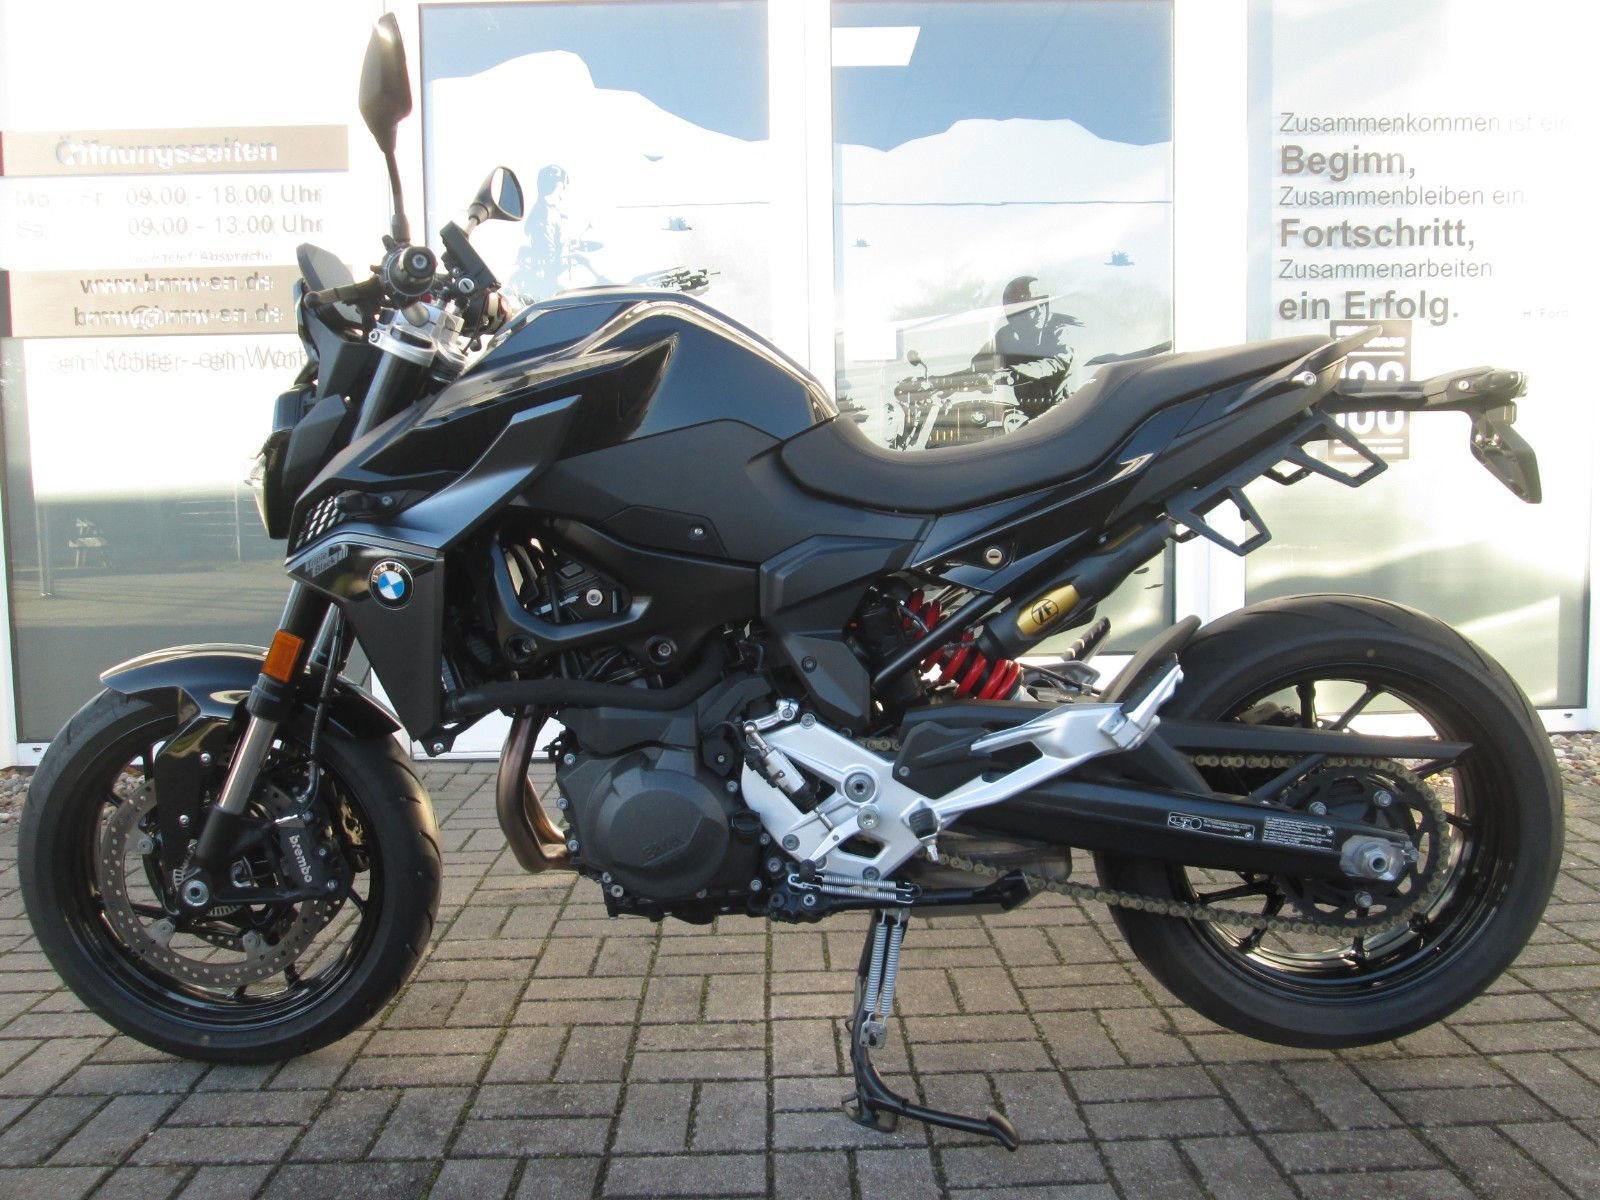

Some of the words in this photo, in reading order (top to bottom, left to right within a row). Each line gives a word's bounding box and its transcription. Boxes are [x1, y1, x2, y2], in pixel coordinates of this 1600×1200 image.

[1279, 112, 1500, 133] Zusammenkommen
[55, 134, 278, 169] Öffnungszeiten
[1281, 145, 1415, 182] Beginn,
[126, 185, 188, 206] 09.00
[212, 184, 272, 206] 18.00
[280, 183, 323, 204] Uhr
[1279, 185, 1484, 206] Zusammenbleiben
[1493, 185, 1524, 205] ein
[128, 215, 189, 236] 09.00
[215, 215, 273, 236] 13.00
[282, 213, 323, 234] Uhr
[1281, 217, 1475, 251] Fortschritt,
[1278, 258, 1493, 279] Zusammenarbeiten
[1279, 291, 1331, 320] ein
[1344, 290, 1459, 326] Erfolg.
[289, 834, 313, 883] brembo
